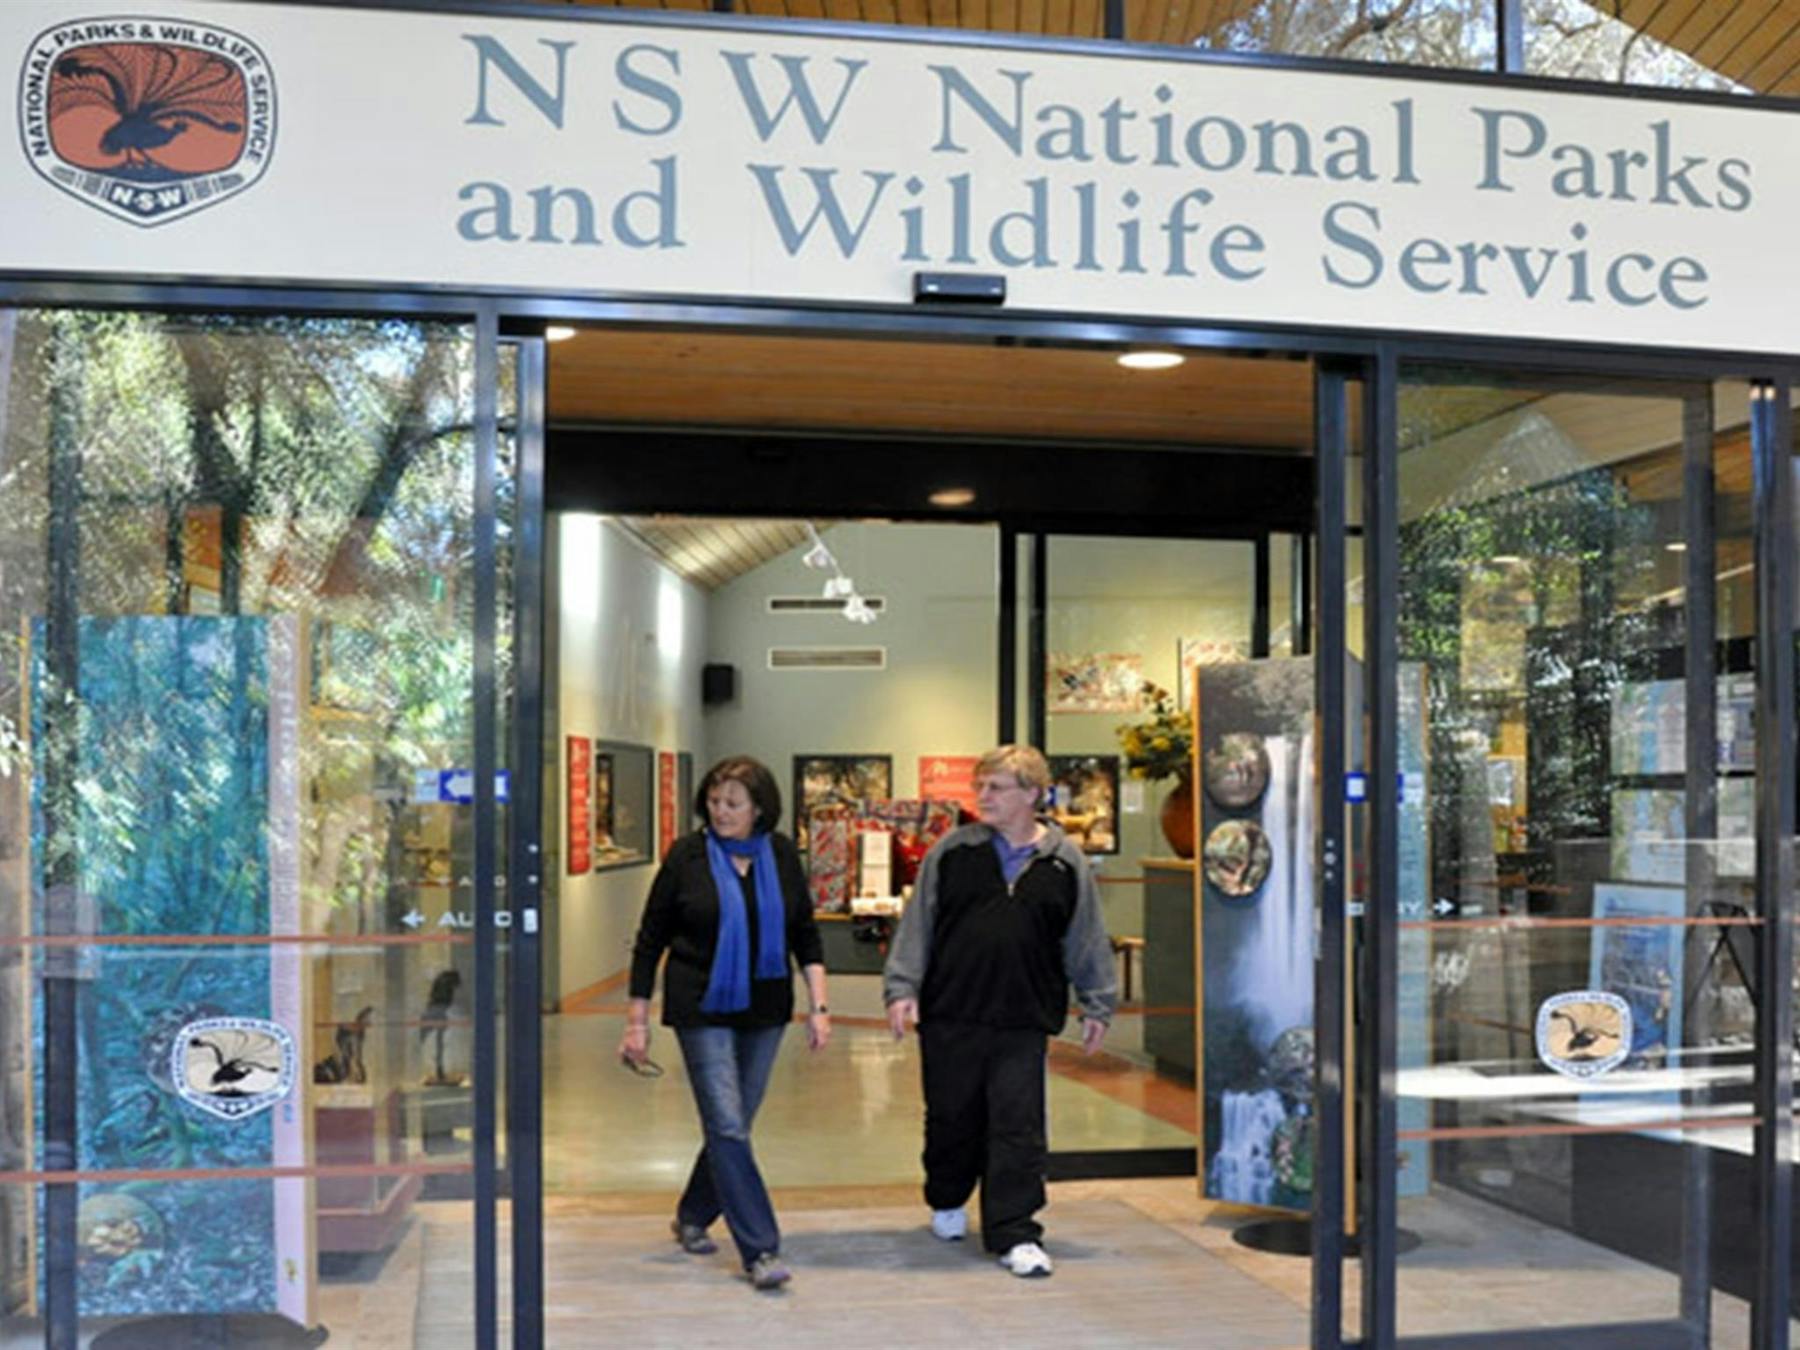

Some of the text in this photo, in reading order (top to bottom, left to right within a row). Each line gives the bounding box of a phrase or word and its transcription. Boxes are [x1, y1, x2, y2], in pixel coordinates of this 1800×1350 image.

[26, 23, 269, 162] NATIONAL PARKS & WILDLIFE SERVICE
[927, 65, 1420, 184] National
[1471, 107, 1751, 211] Parks
[457, 156, 1707, 309] and Wildlife Service
